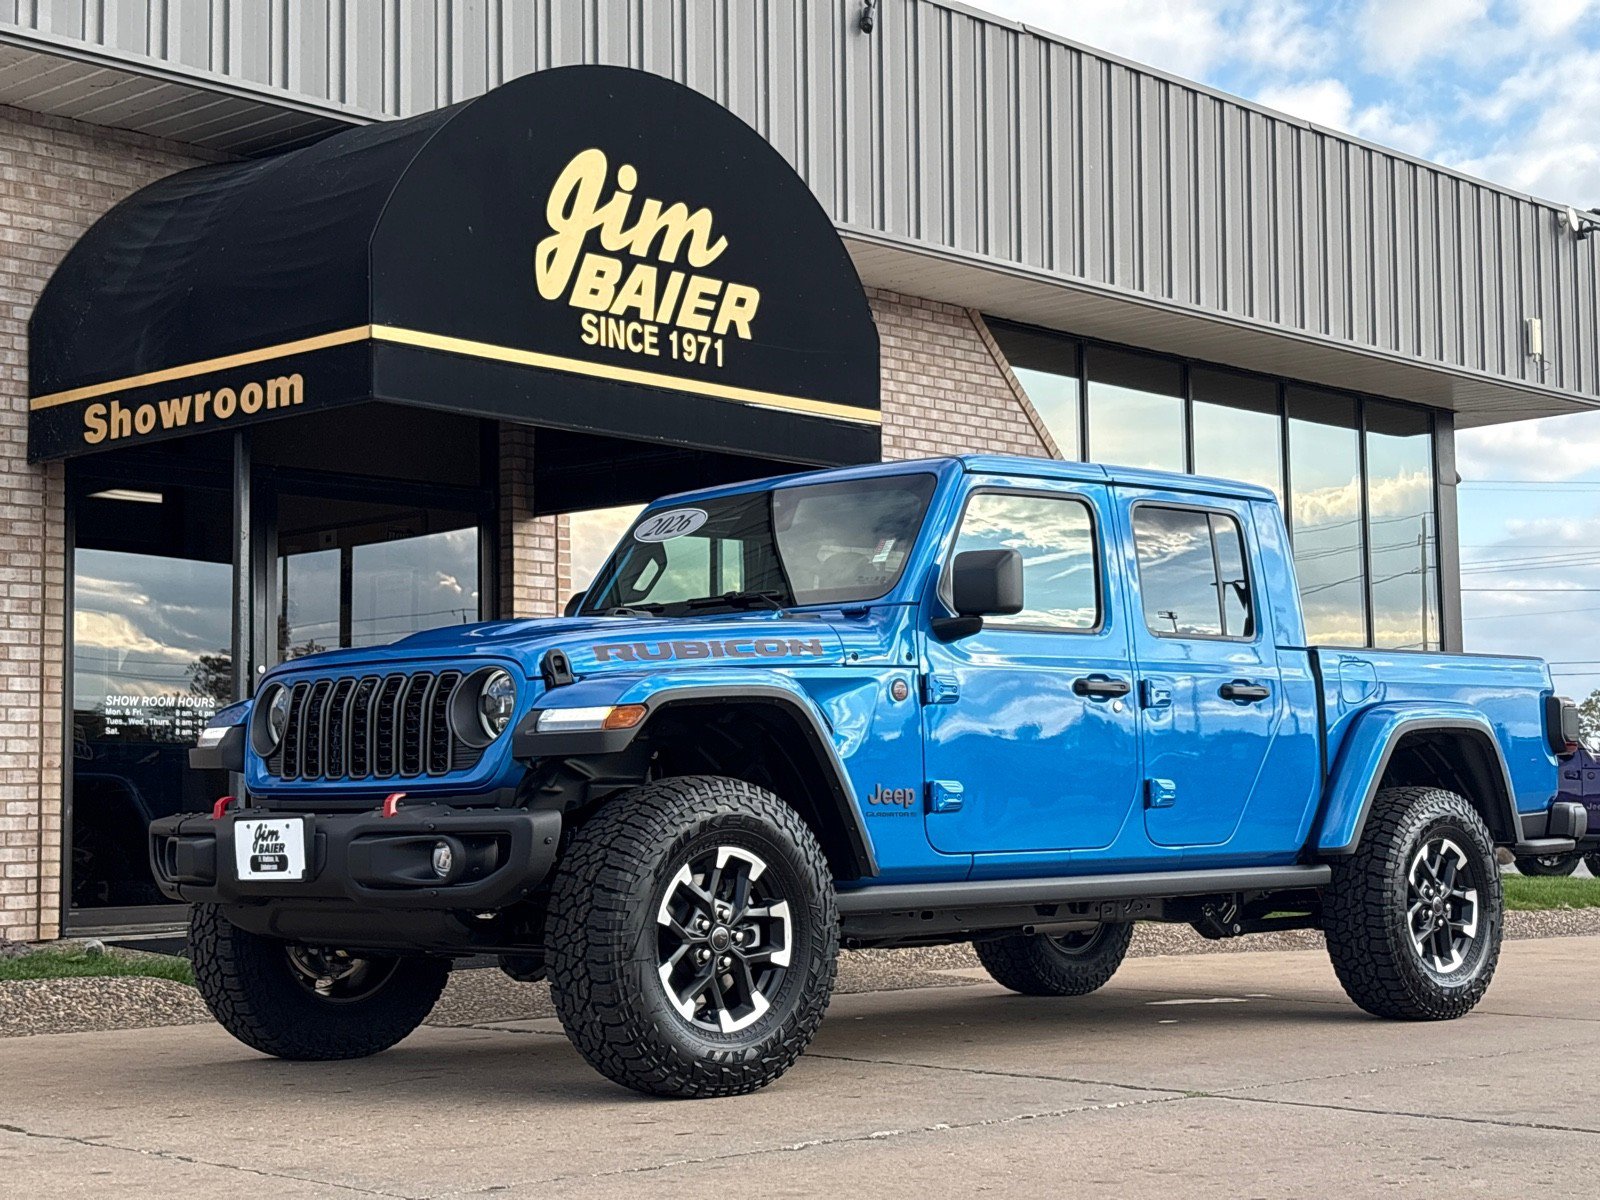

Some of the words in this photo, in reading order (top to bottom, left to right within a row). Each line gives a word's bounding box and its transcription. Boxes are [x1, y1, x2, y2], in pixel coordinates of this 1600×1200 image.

[535, 148, 729, 300] Jim
[568, 252, 760, 340] BAIER
[581, 313, 660, 356] SINCE
[669, 330, 723, 367] 1971
[83, 373, 304, 444] Showroom
[641, 512, 697, 537] 2026
[592, 639, 824, 662] RUBICON
[105, 695, 139, 706] SHOW
[141, 696, 175, 707] ROOM
[177, 697, 215, 708] HOURS
[105, 708, 123, 716] Mon.
[125, 708, 131, 716] &
[204, 711, 216, 719] pm
[105, 727, 120, 735] Sat.
[149, 718, 172, 726] Thurs.
[868, 783, 915, 809] Jeep
[252, 822, 281, 853] Jim
[258, 843, 286, 854] BAIER
